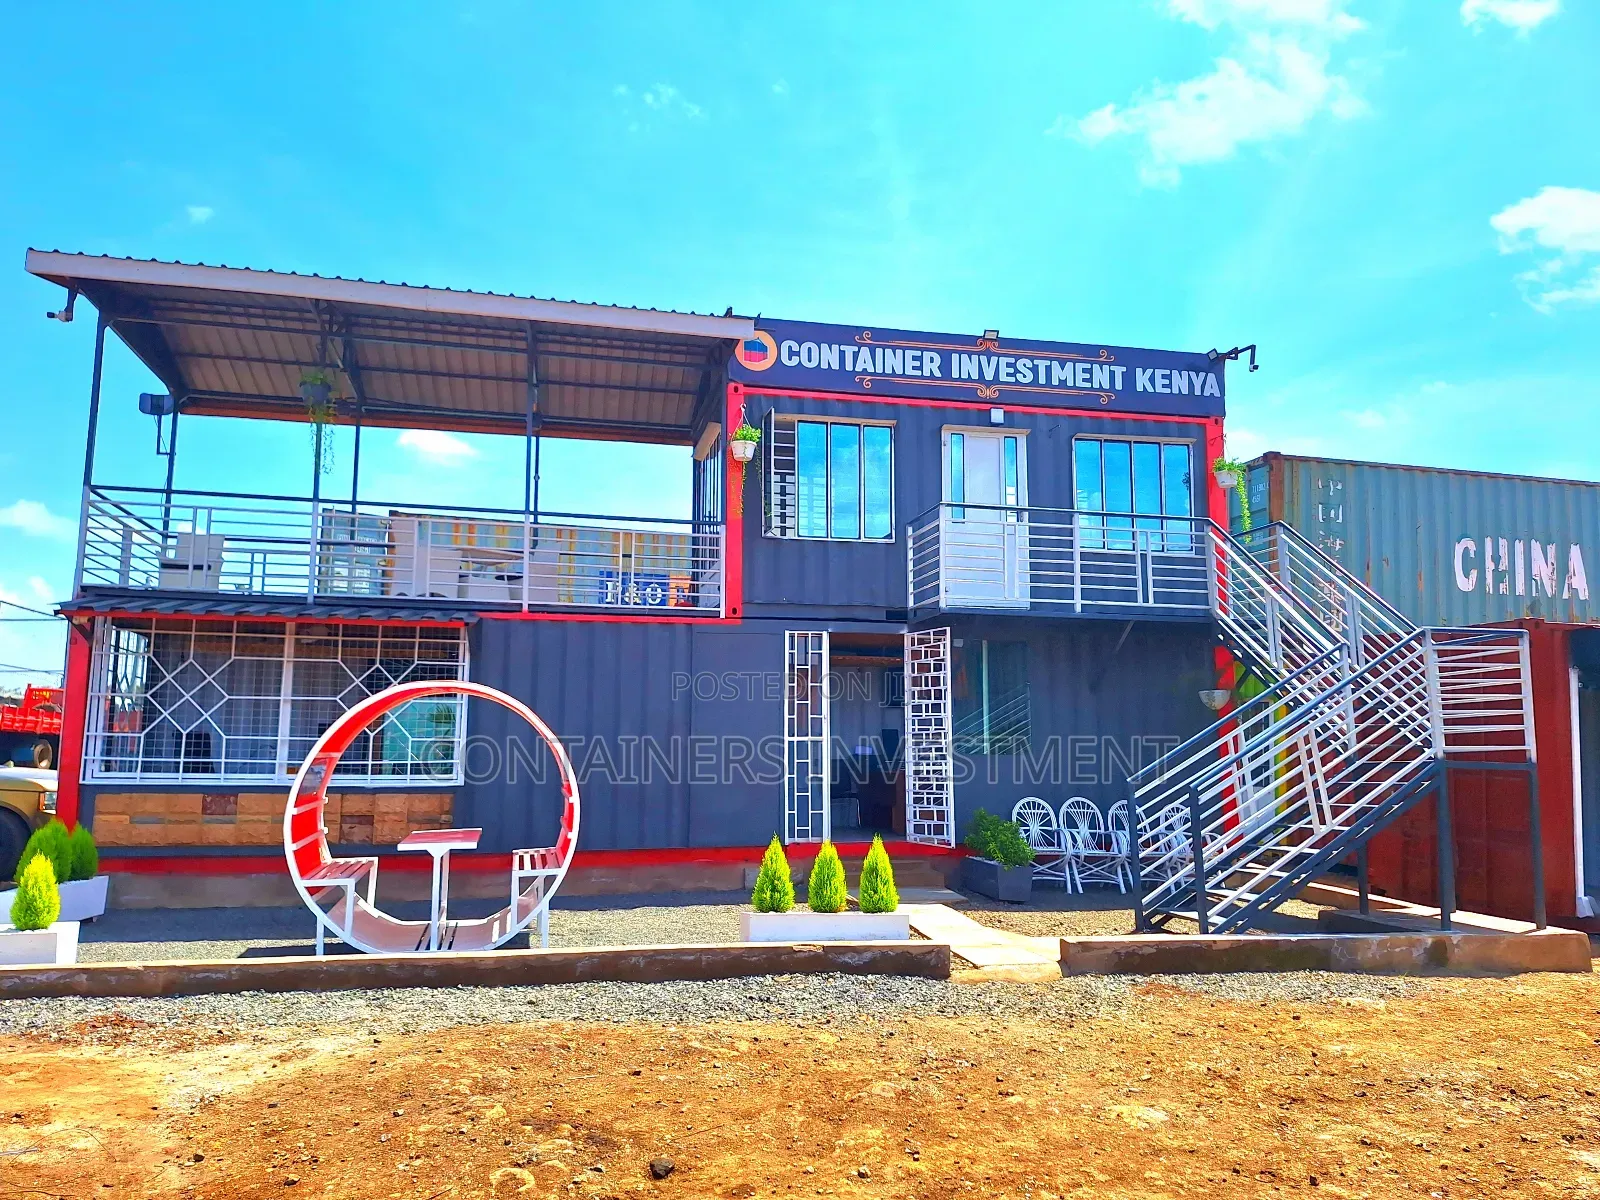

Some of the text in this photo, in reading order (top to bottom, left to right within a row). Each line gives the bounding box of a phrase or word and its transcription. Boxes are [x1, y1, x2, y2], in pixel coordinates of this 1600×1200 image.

[780, 339, 1221, 397] CONTAINER INVESTMENT KENYA
[1454, 536, 1589, 600] CHINA
